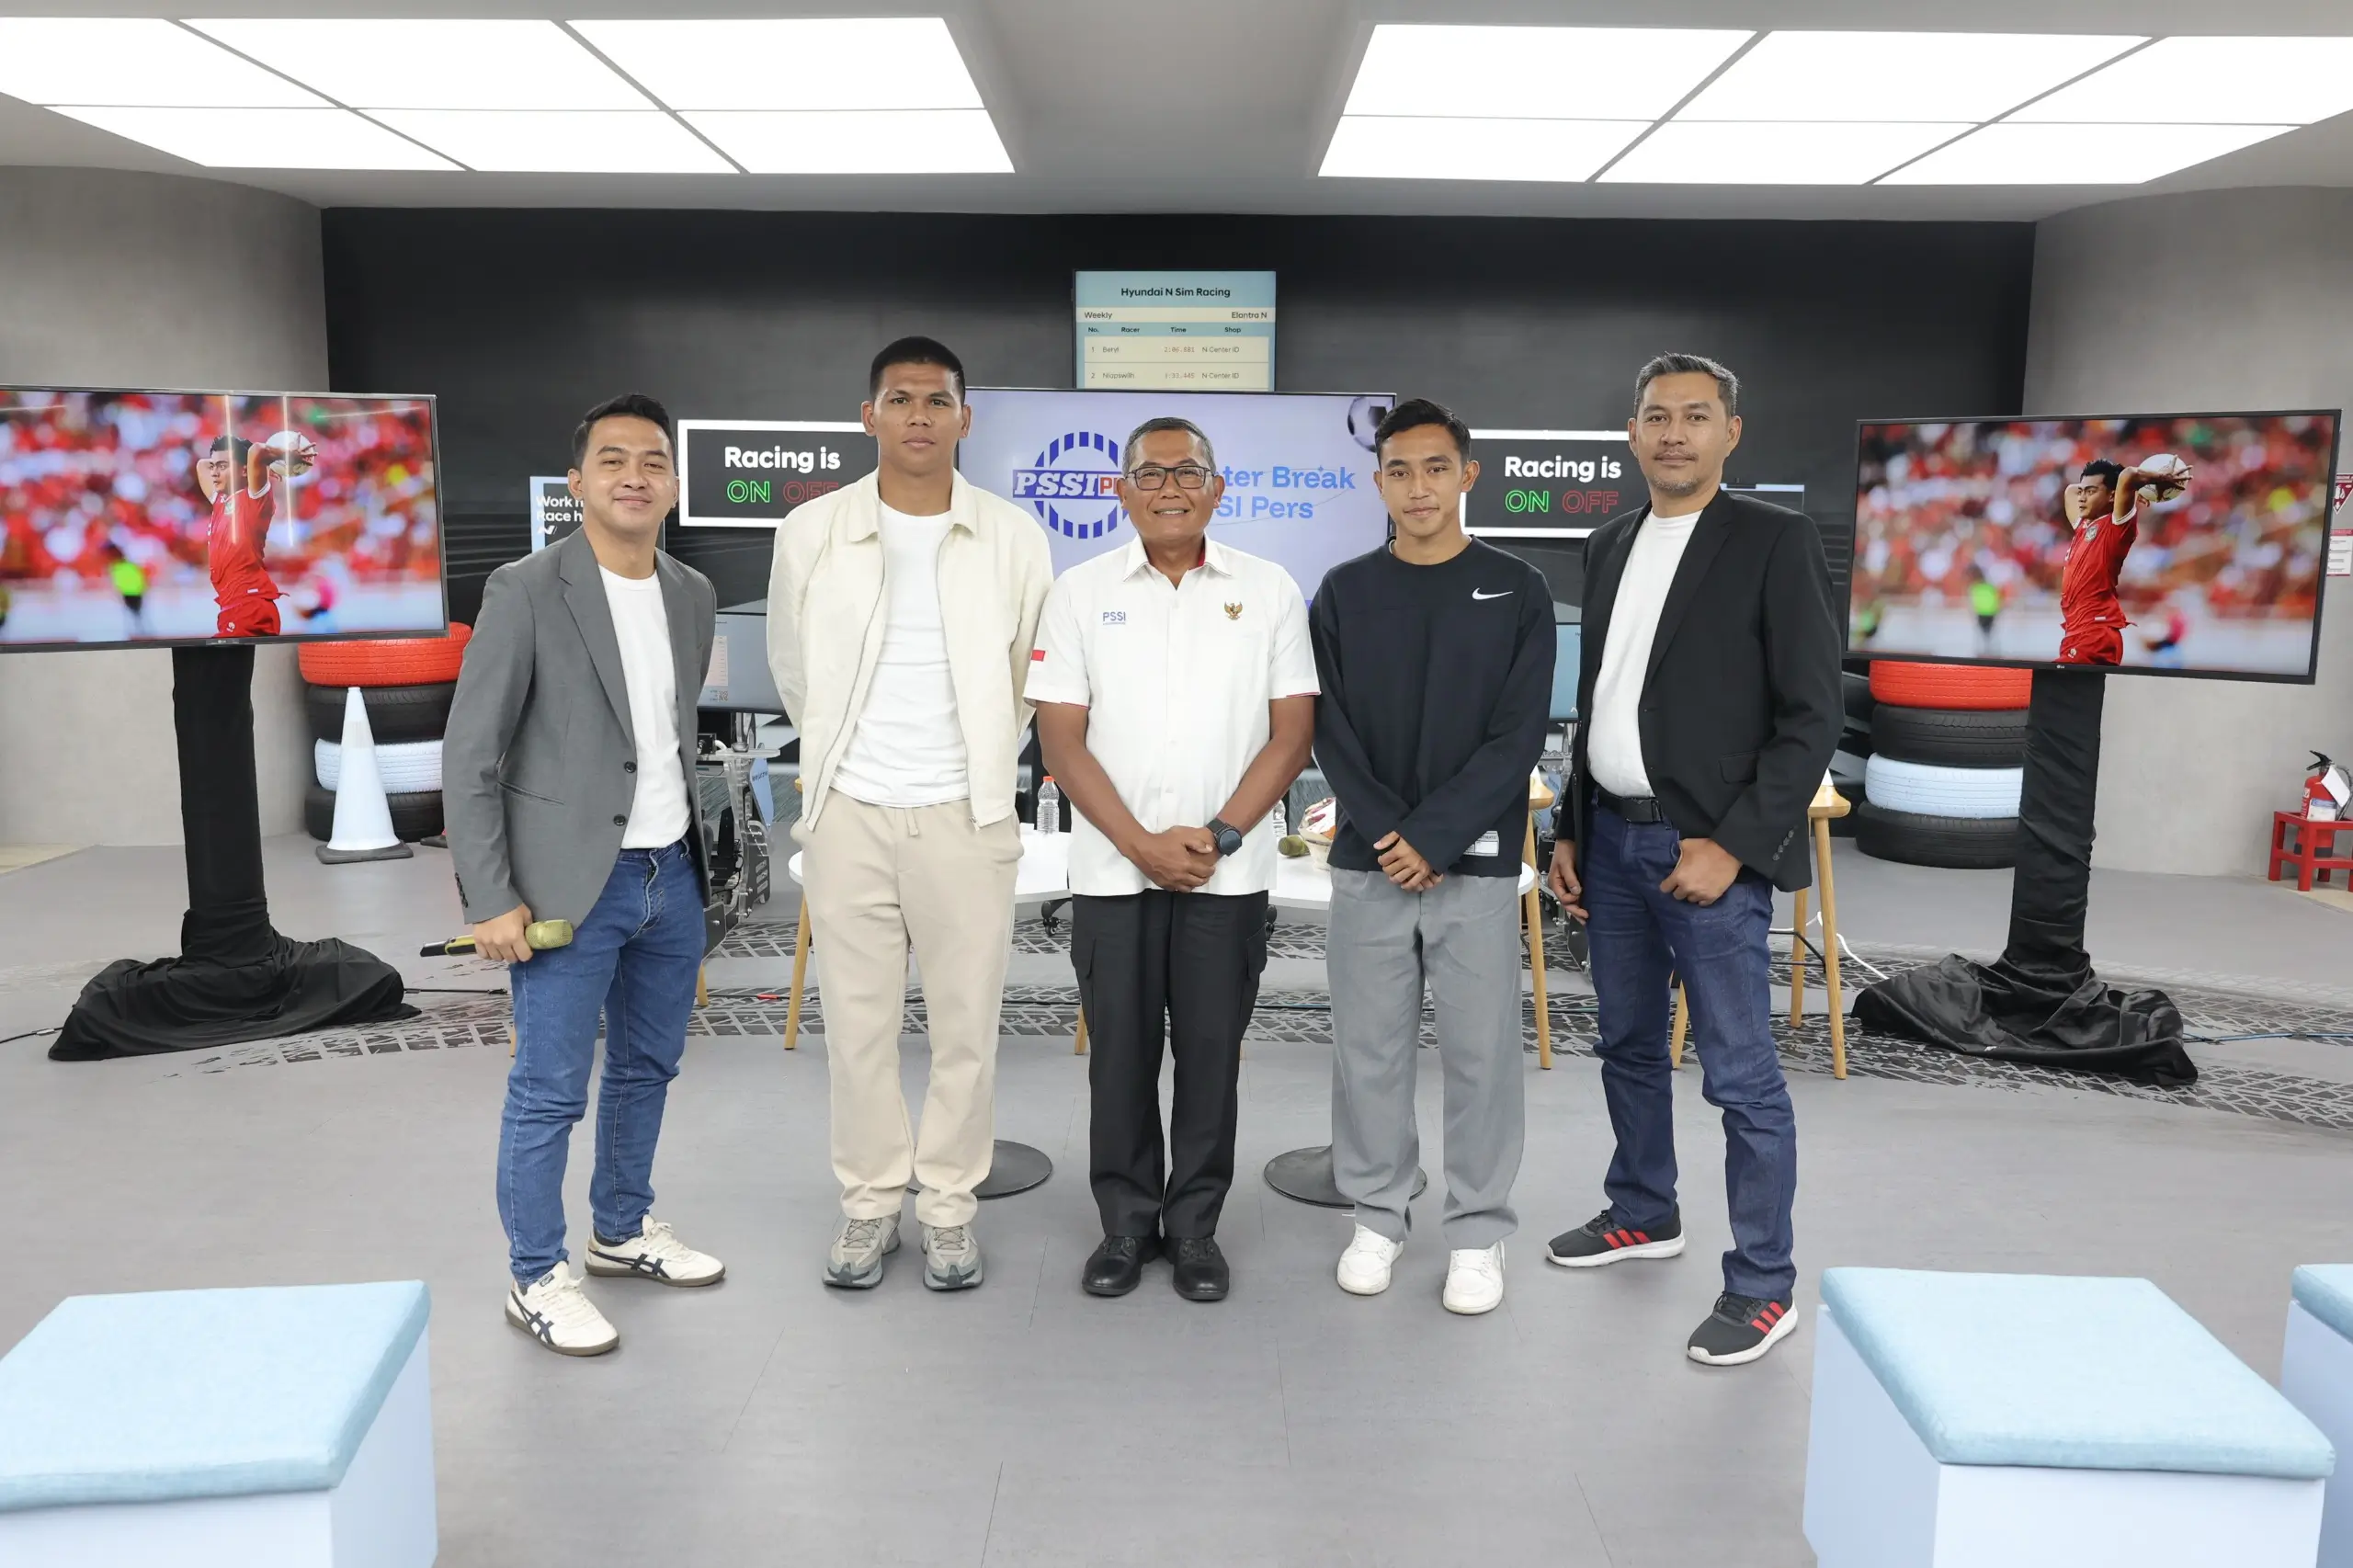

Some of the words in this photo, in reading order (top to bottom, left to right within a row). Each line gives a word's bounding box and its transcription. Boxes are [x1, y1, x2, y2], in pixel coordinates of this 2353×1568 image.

[1120, 287, 1164, 298] Hyundai
[1165, 288, 1173, 296] N
[1176, 287, 1194, 297] Sim
[1196, 287, 1231, 298] Racing
[1084, 312, 1113, 320] Weekly
[724, 445, 815, 474] Racing
[820, 446, 841, 471] is
[1504, 455, 1596, 483] Racing
[1600, 456, 1622, 479] is
[1014, 472, 1099, 496] PSSI
[1271, 466, 1357, 490] Break
[536, 495, 573, 507] Work
[726, 480, 771, 504] ON
[1505, 489, 1550, 513] ON
[1563, 490, 1620, 514] OFF
[537, 511, 572, 522] Race
[1251, 495, 1314, 519] Pers
[1102, 611, 1126, 622] PSSI
